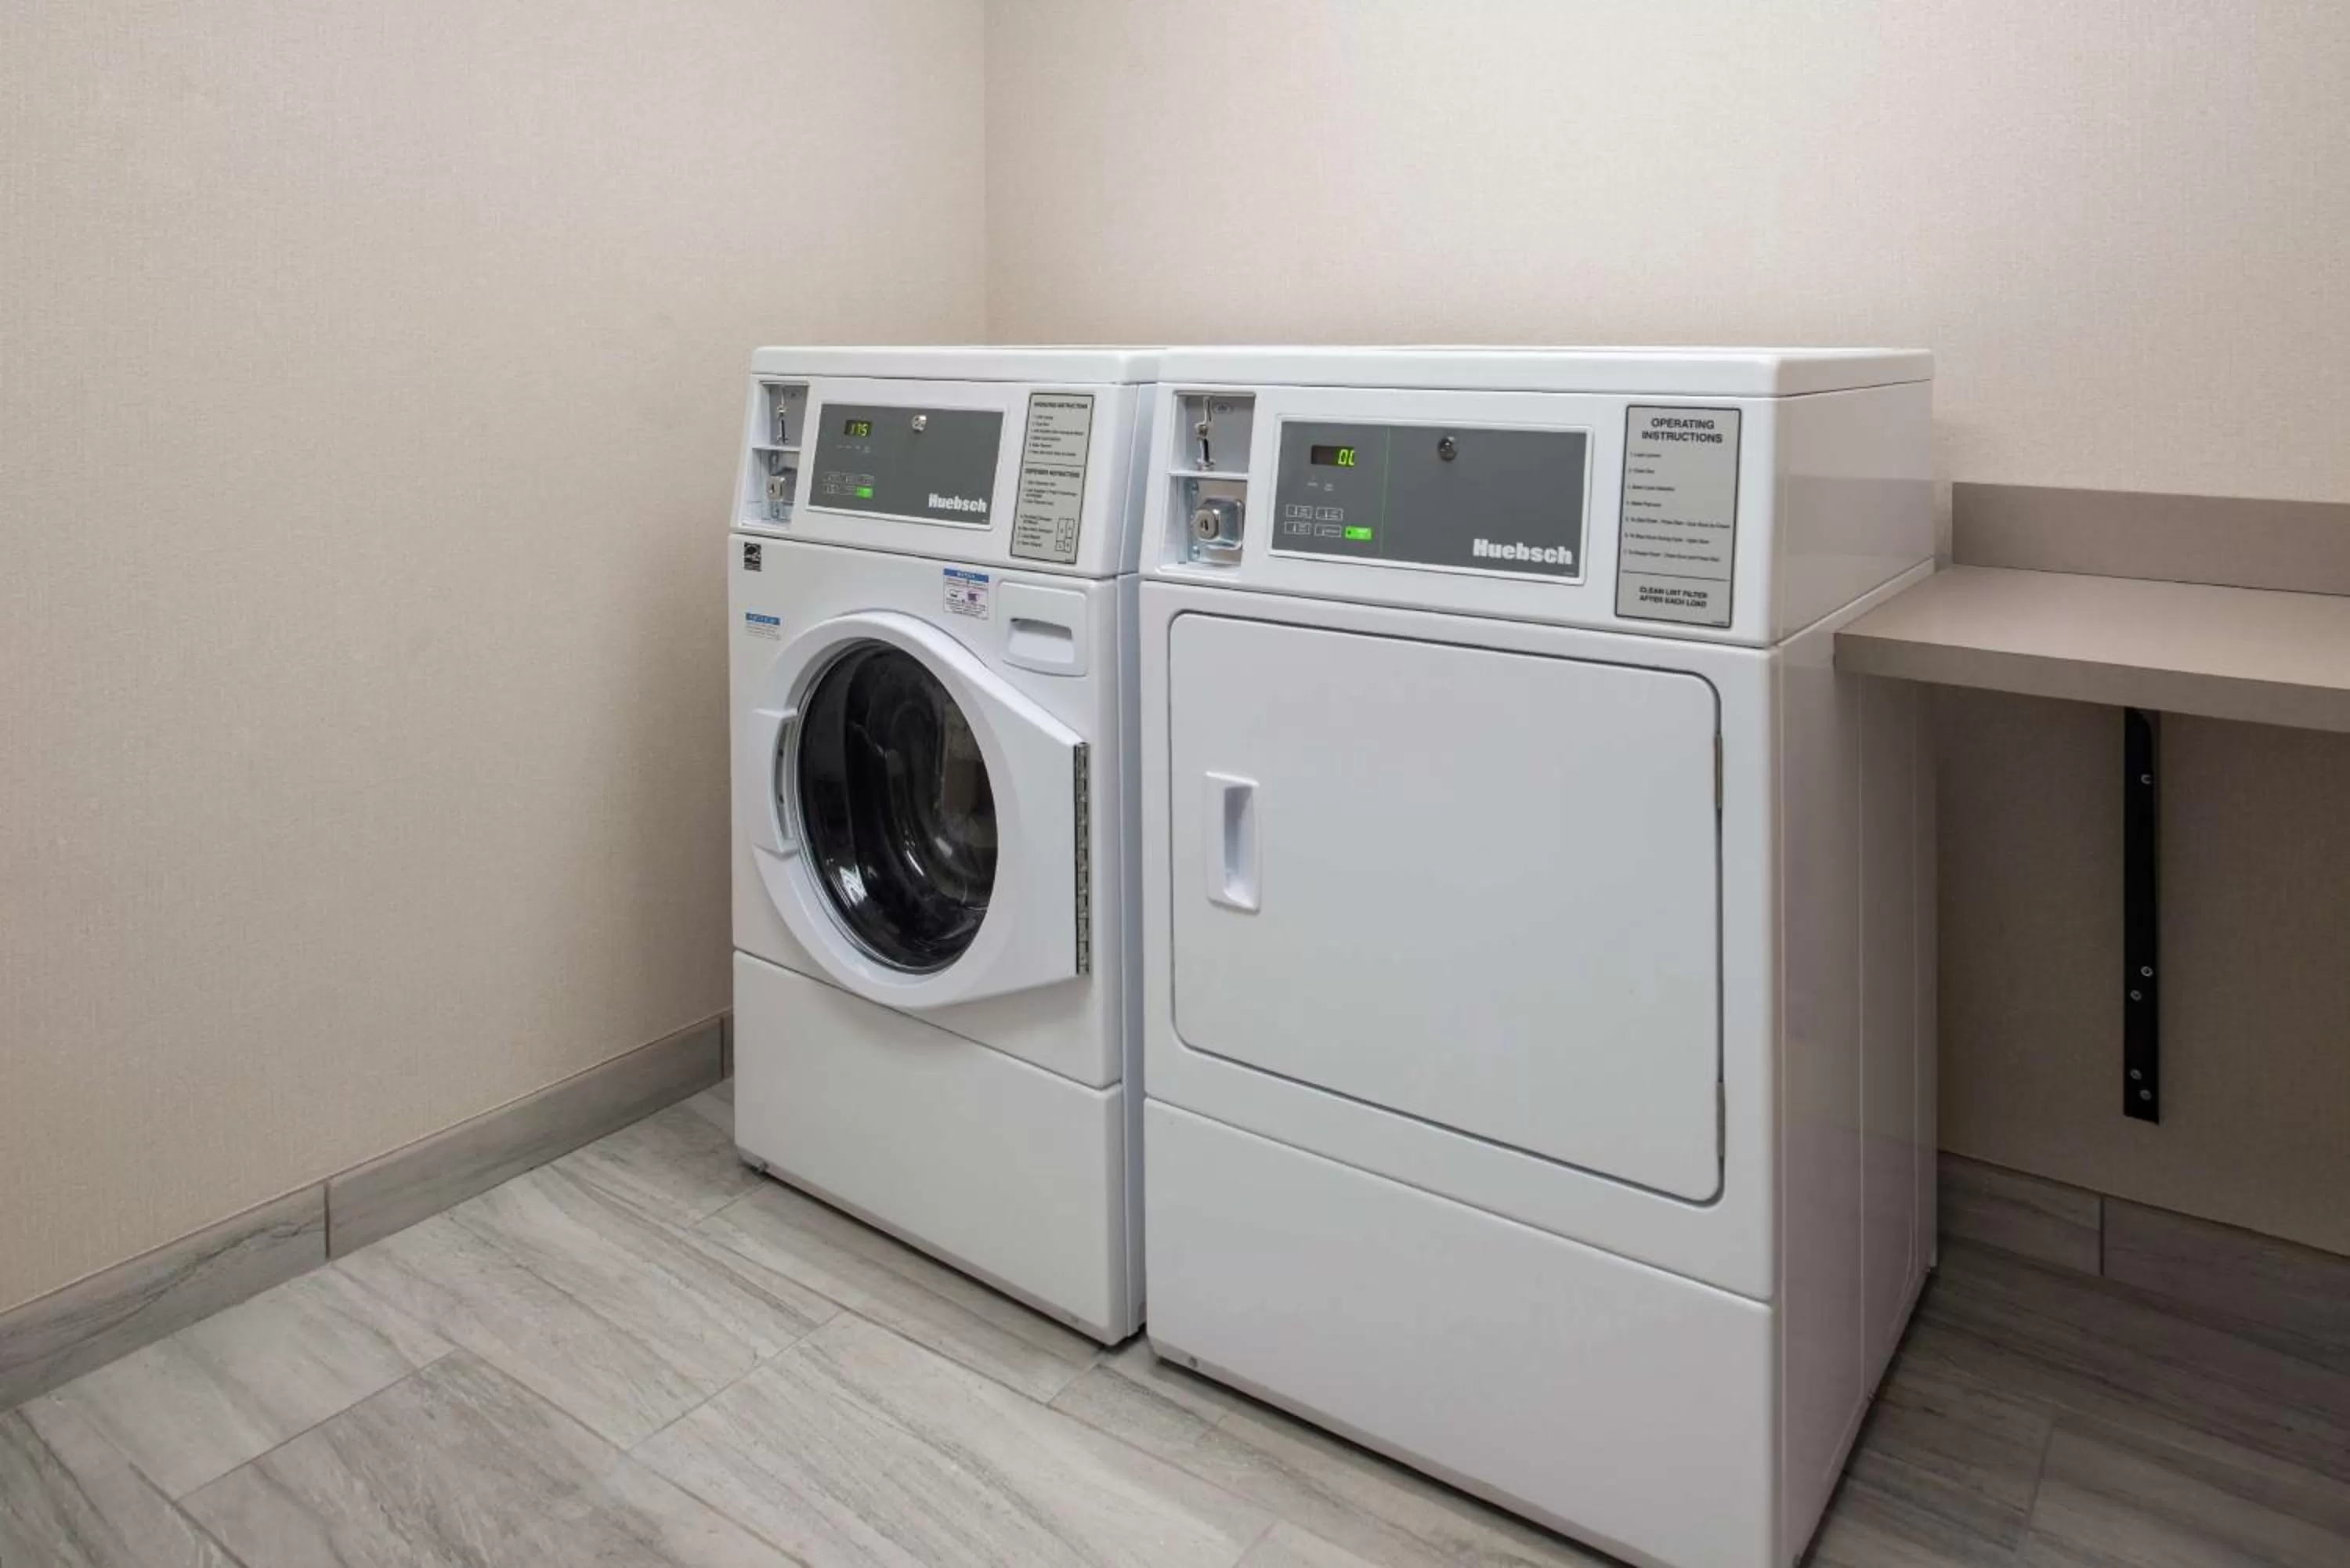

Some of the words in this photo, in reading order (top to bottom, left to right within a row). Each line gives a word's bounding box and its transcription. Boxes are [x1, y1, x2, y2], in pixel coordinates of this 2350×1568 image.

[1650, 417, 1715, 429] OPERATING
[1642, 431, 1723, 443] INSTRUCTIONS
[928, 492, 987, 513] Huebsch
[1473, 538, 1573, 565] Huebsch
[1640, 586, 1664, 595] CLEAN
[1683, 590, 1708, 599] FILTER
[1640, 594, 1663, 603] AFTER
[1686, 599, 1707, 608] LOAD
